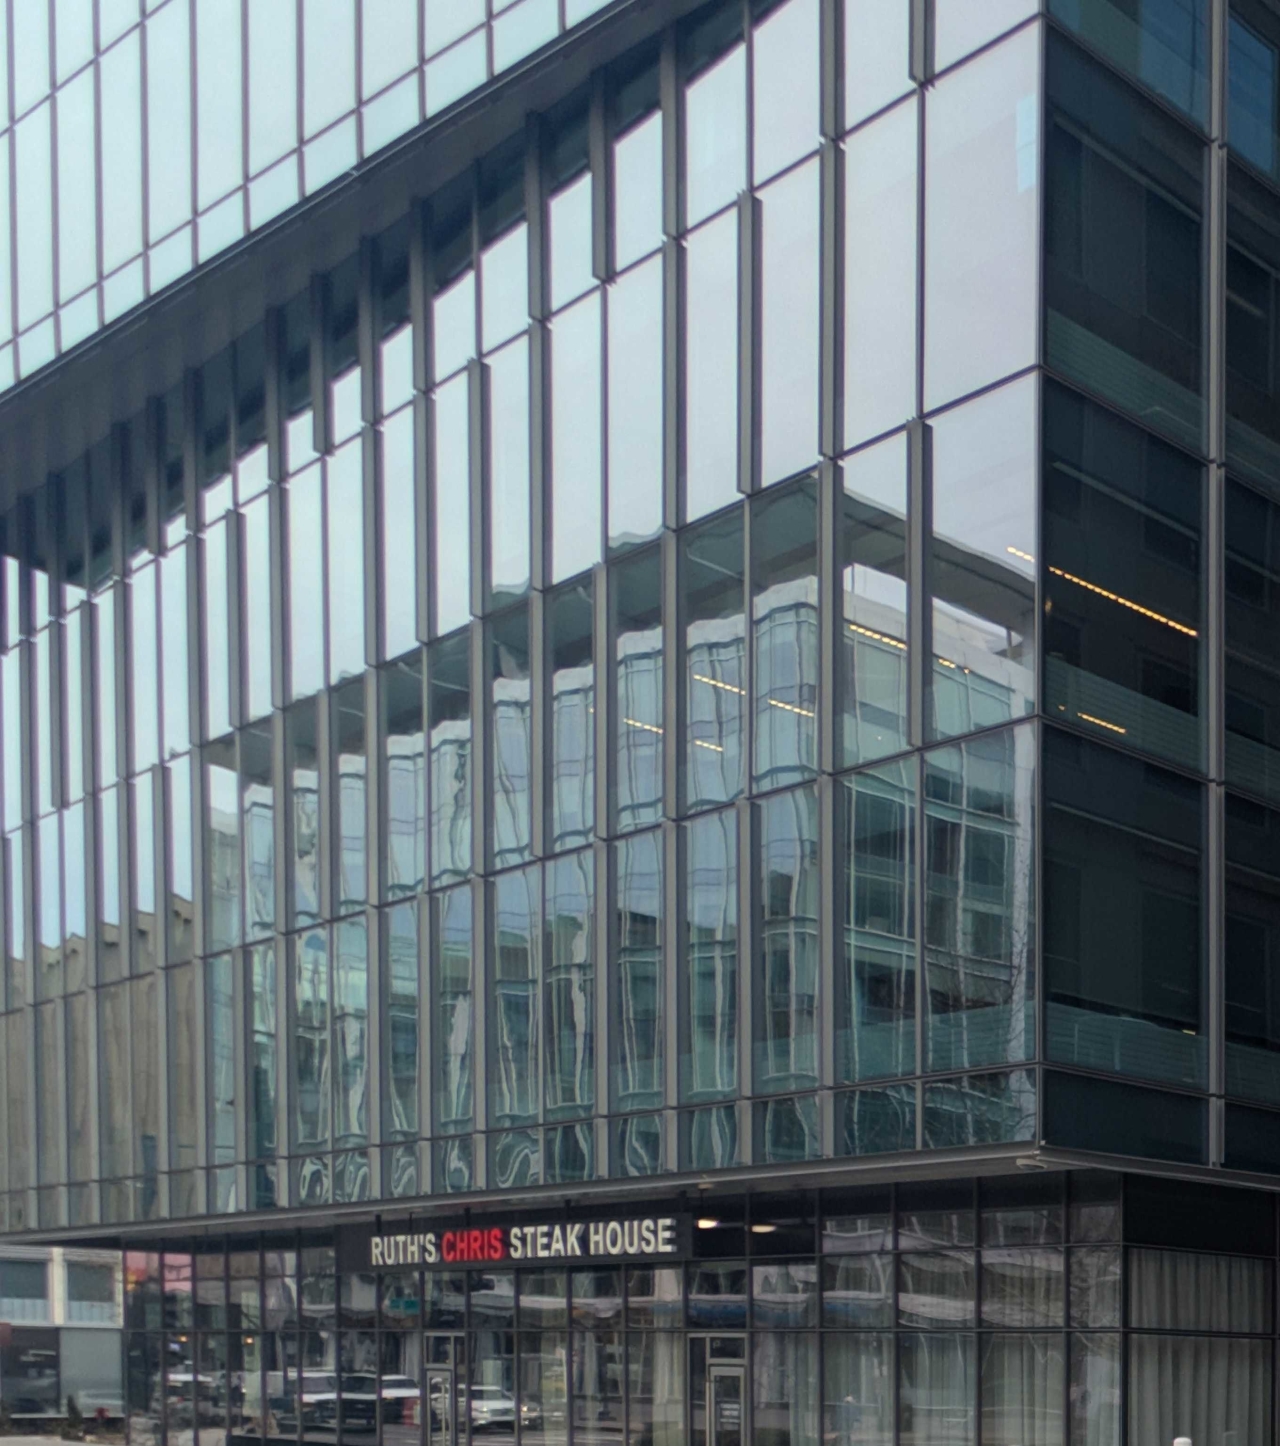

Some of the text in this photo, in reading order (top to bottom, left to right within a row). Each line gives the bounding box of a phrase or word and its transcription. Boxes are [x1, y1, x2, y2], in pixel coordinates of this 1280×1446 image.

[371, 1218, 676, 1265] RUTH'S CHRIS STEAK HOUSE
